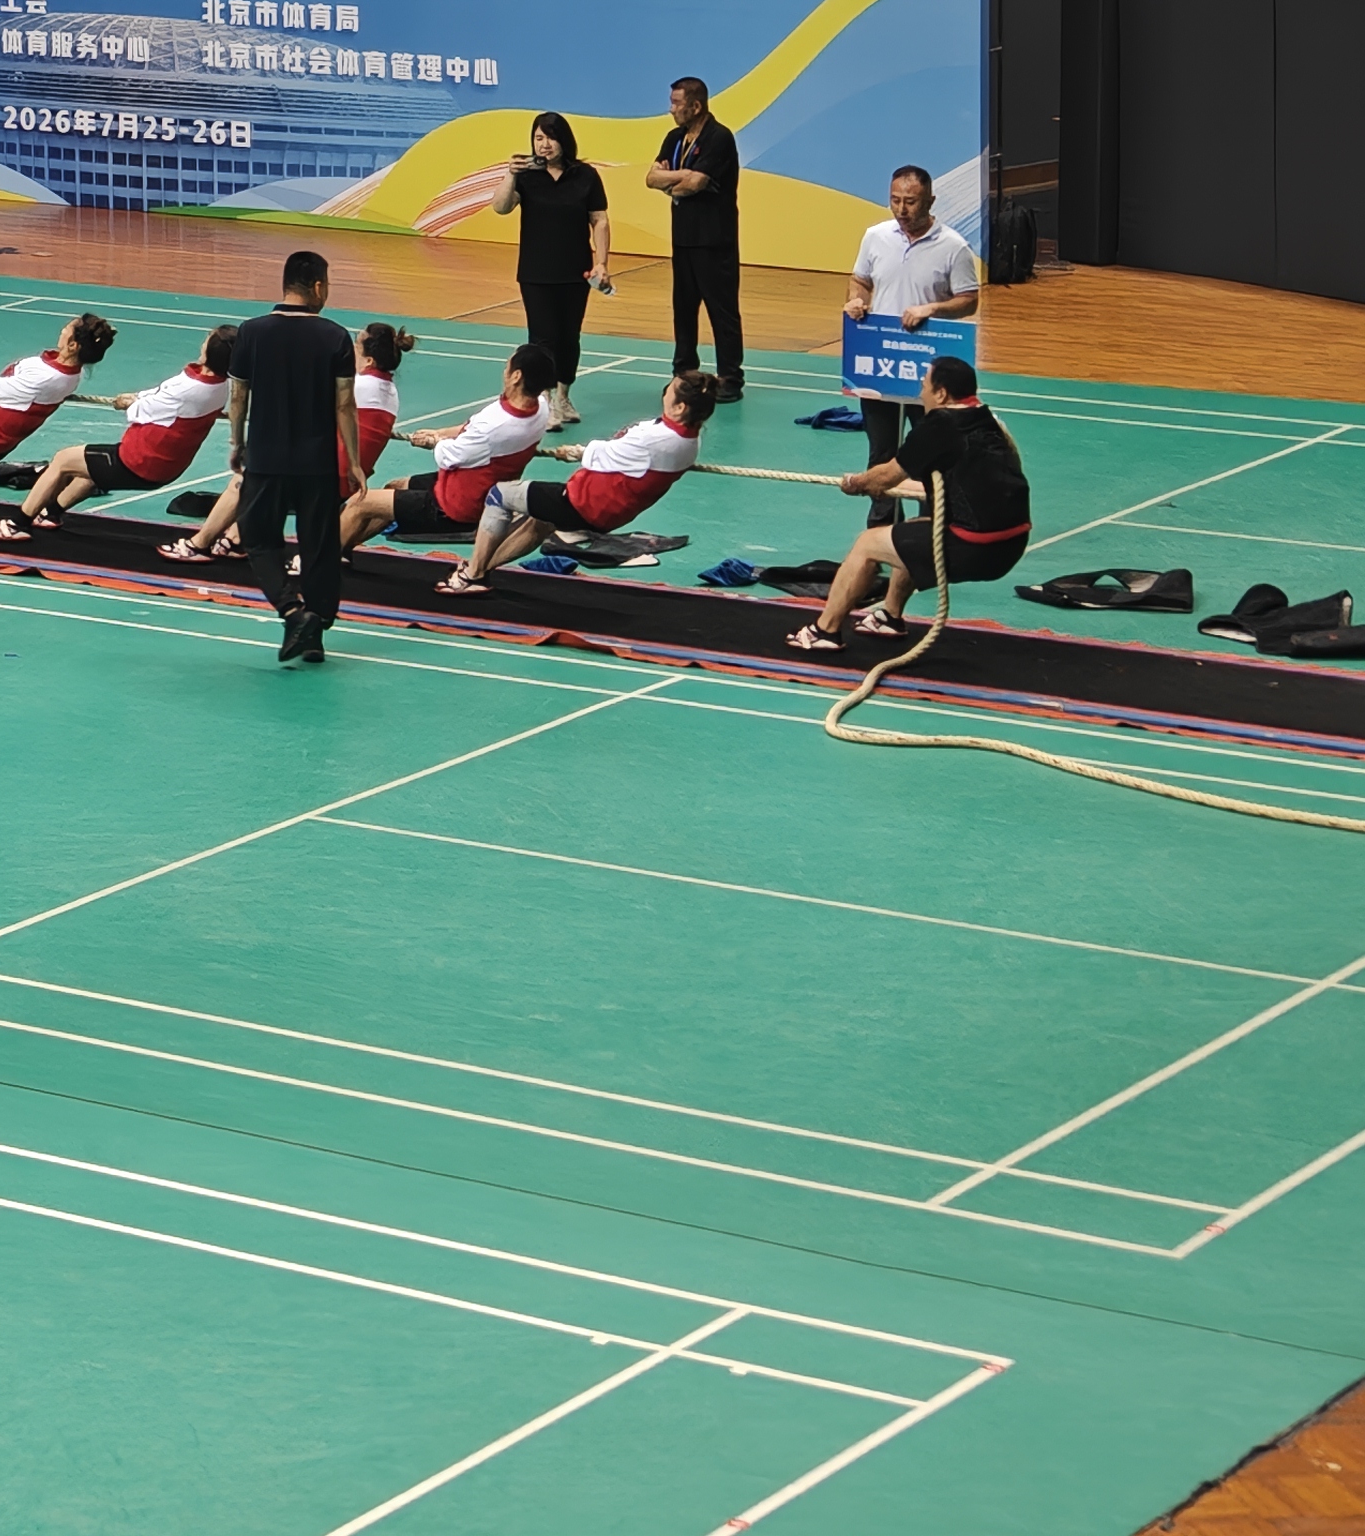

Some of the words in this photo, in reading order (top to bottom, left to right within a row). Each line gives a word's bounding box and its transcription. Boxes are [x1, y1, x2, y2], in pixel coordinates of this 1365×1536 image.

[202, 40, 499, 86] 北京市社会体育管理中心
[3, 105, 251, 149] 2026年7月25-26日
